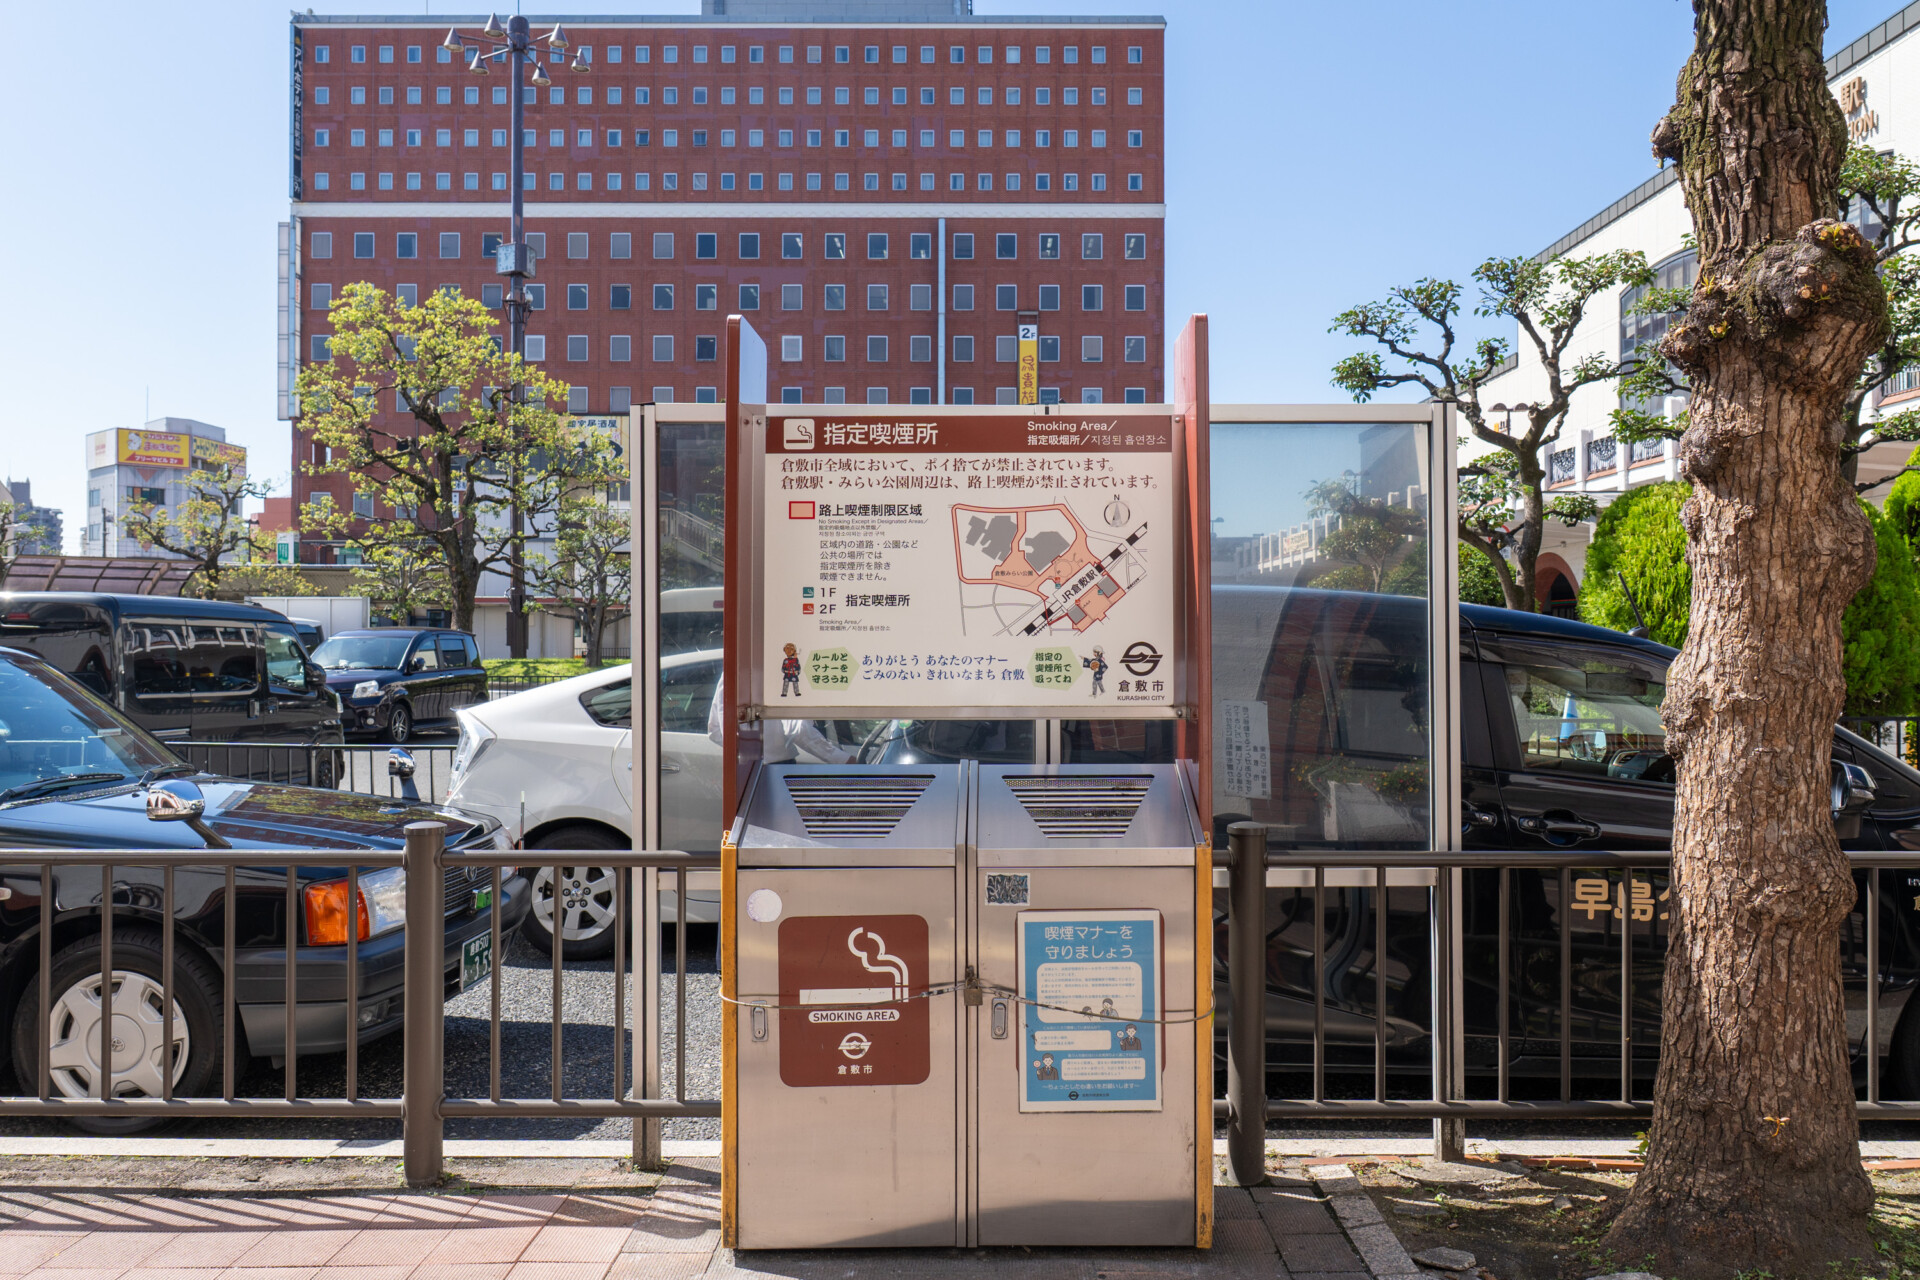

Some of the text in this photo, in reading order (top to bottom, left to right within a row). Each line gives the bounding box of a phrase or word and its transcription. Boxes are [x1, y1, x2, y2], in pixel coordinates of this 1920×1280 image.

[1022, 328, 1036, 338] 2F
[1028, 421, 1076, 432] Smoking
[824, 422, 938, 445] 指定喫煙所
[1124, 434, 1166, 446] 흡연장소
[781, 458, 1114, 472] 倉敷市全域において、ポイ捨てが禁止されています。
[781, 475, 1157, 489] 倉敷駅・みらい公園周辺は、路上喫煙が禁止されています。
[819, 504, 922, 516] 路上喫煙制限区域
[820, 540, 918, 549] 区域内の道路・公園など
[820, 551, 882, 560] 公共の場所では
[820, 562, 890, 570] 指定喫煙所を除き
[820, 572, 887, 581] 喫煙できません。
[1062, 569, 1098, 604] JR倉敷駅
[820, 588, 836, 597] 1F
[846, 594, 910, 607] 指定喫煙所
[820, 604, 836, 614] 2F
[812, 653, 848, 661] ルールと
[862, 655, 1008, 666] ありがとう あなたのマナー
[1035, 653, 1062, 661] 指定の
[812, 664, 848, 672] マナーを
[1035, 664, 1072, 673] 喫煙所で
[812, 675, 848, 684] 守ろうね
[862, 668, 1024, 681] ごみのない きれいなまち 倉敷
[1035, 675, 1072, 684] 吸ってね
[1118, 680, 1164, 692] 倉敷市
[1045, 925, 1133, 940] 喫煙マナーを
[1045, 945, 1133, 960] 守りましょう
[813, 1011, 896, 1022] SMOKING AREA
[838, 1065, 873, 1075] 倉敷市
